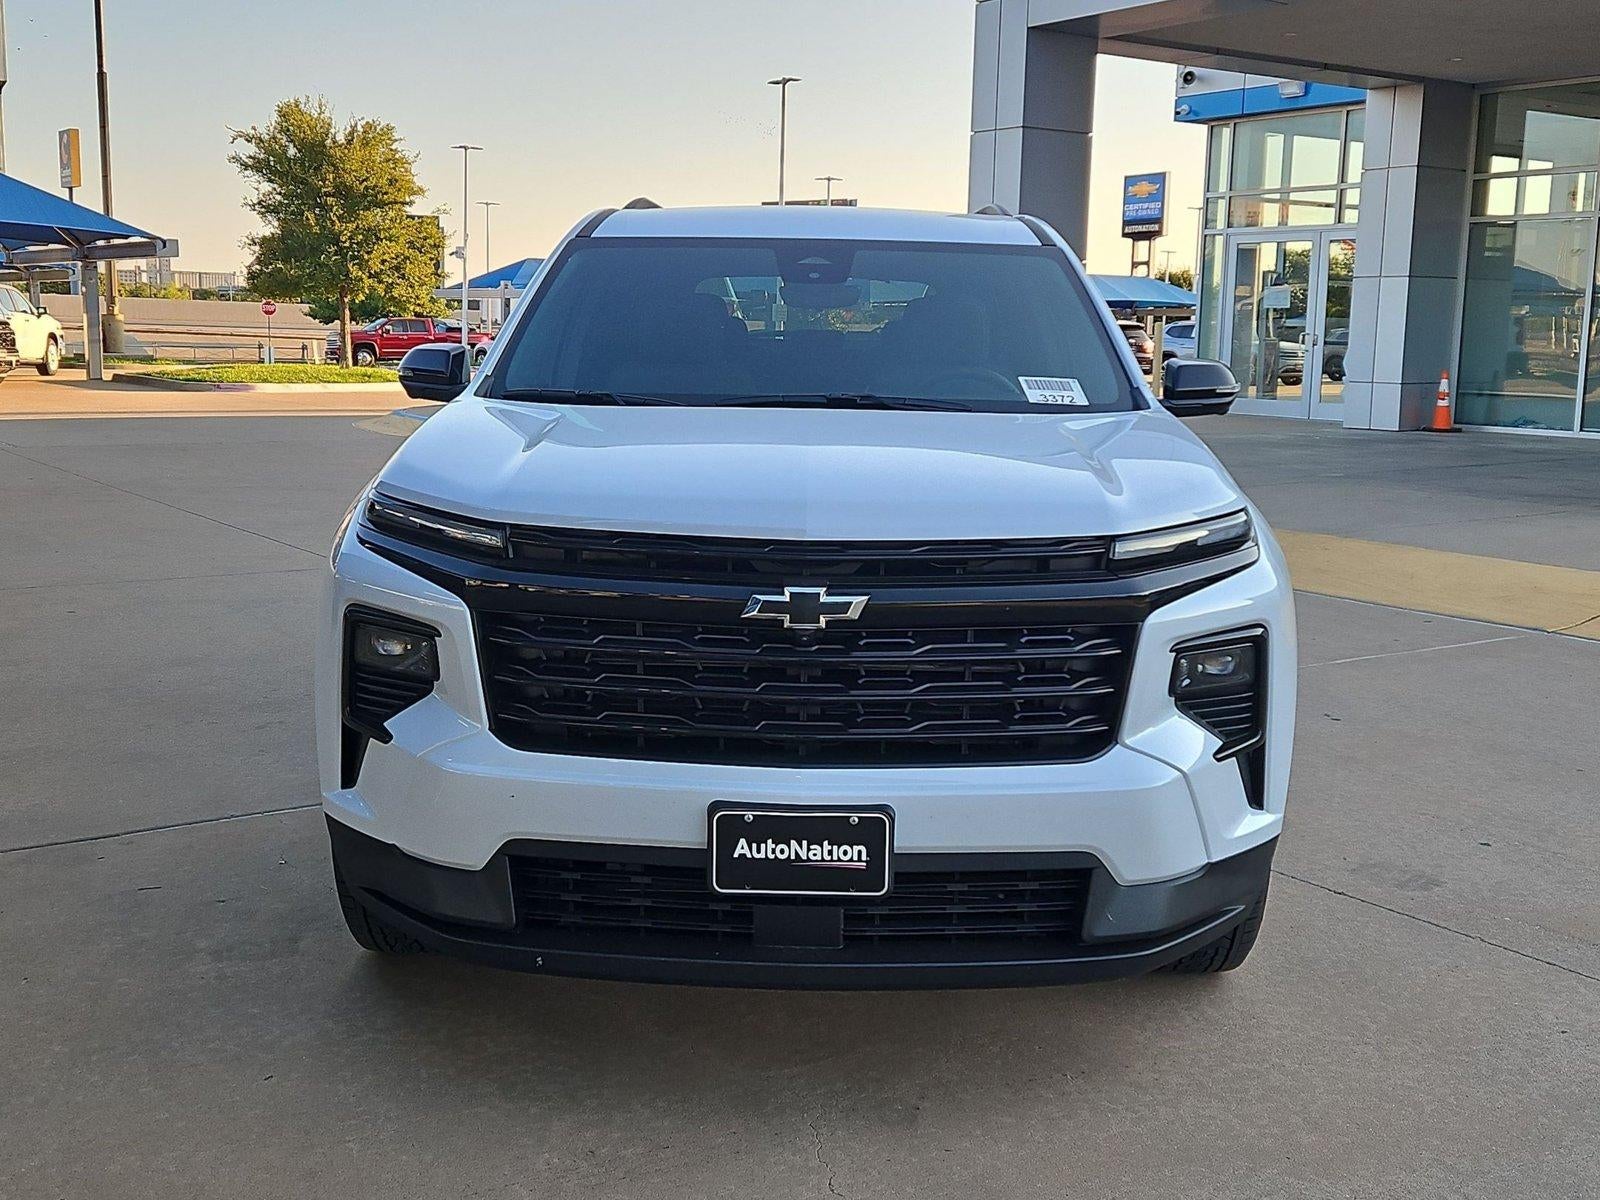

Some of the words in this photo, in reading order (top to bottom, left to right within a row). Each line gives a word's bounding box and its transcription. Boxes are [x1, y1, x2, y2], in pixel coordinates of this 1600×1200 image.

[1125, 202, 1161, 210] CERTIFIED
[1124, 224, 1159, 233] AUTONATION
[262, 304, 276, 312] STOP
[1039, 394, 1077, 403] 3372
[733, 838, 867, 861] AutoNation
